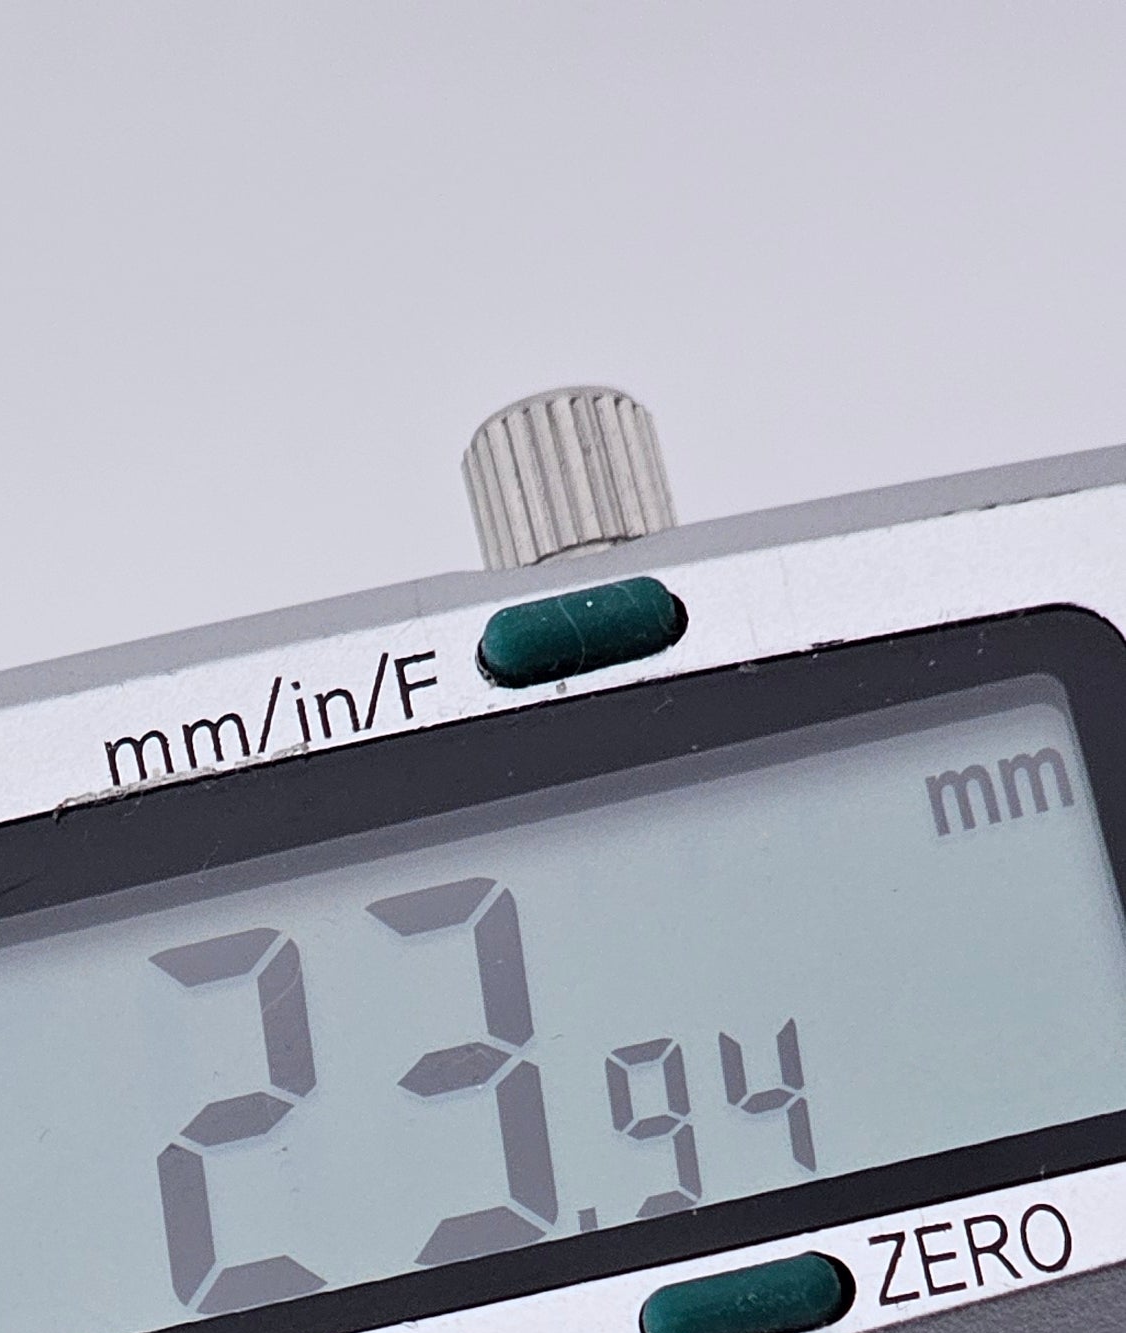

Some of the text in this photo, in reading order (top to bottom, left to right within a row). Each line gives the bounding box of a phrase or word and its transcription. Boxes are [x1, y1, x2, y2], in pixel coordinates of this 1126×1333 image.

[103, 650, 440, 787] mm/in/F
[924, 744, 1076, 838] mm
[148, 876, 817, 1314] 23.94
[867, 1201, 1074, 1308] ZERO
